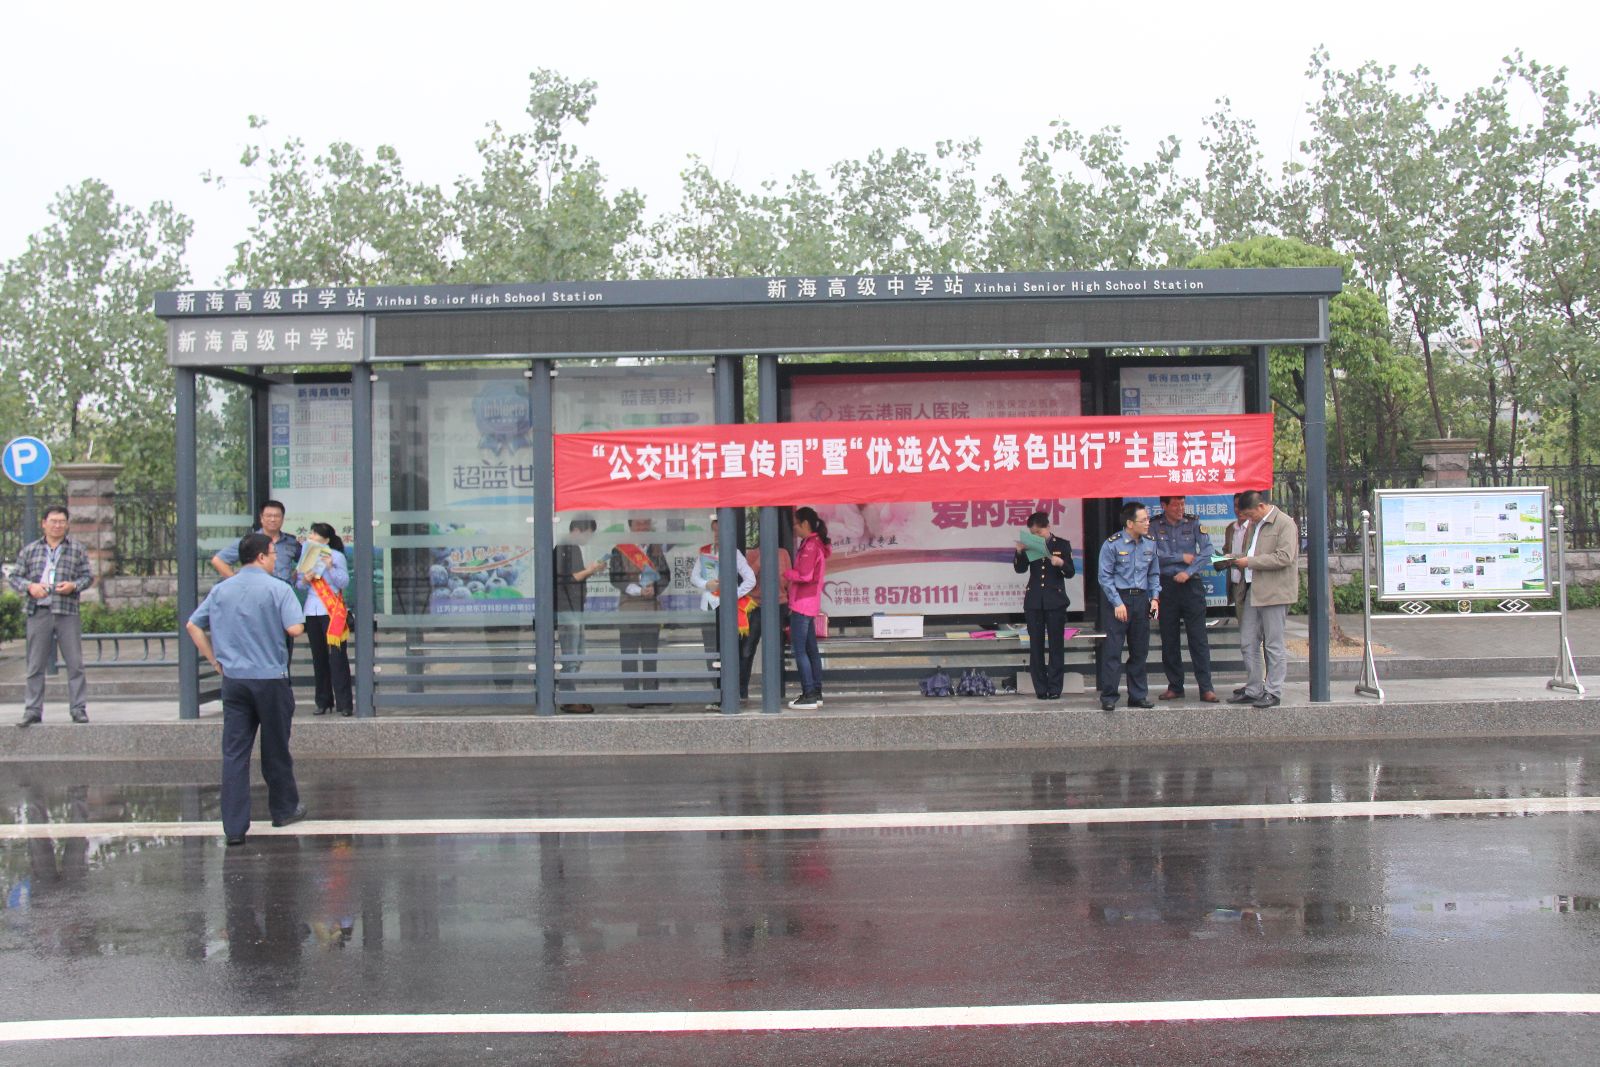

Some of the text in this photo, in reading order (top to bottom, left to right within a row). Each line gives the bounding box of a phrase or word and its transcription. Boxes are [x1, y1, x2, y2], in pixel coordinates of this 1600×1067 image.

[767, 276, 964, 298] 新海高级中学站
[974, 280, 1204, 293] Xinhai Senior High School Station
[176, 289, 366, 312] 新海高级中学站
[376, 292, 603, 306] Xinhai Seior High School Station
[177, 328, 355, 352] 新海高级中学站
[837, 402, 970, 421] 连云港丽人医院
[11, 443, 37, 476] P
[874, 585, 959, 605] 85781111
